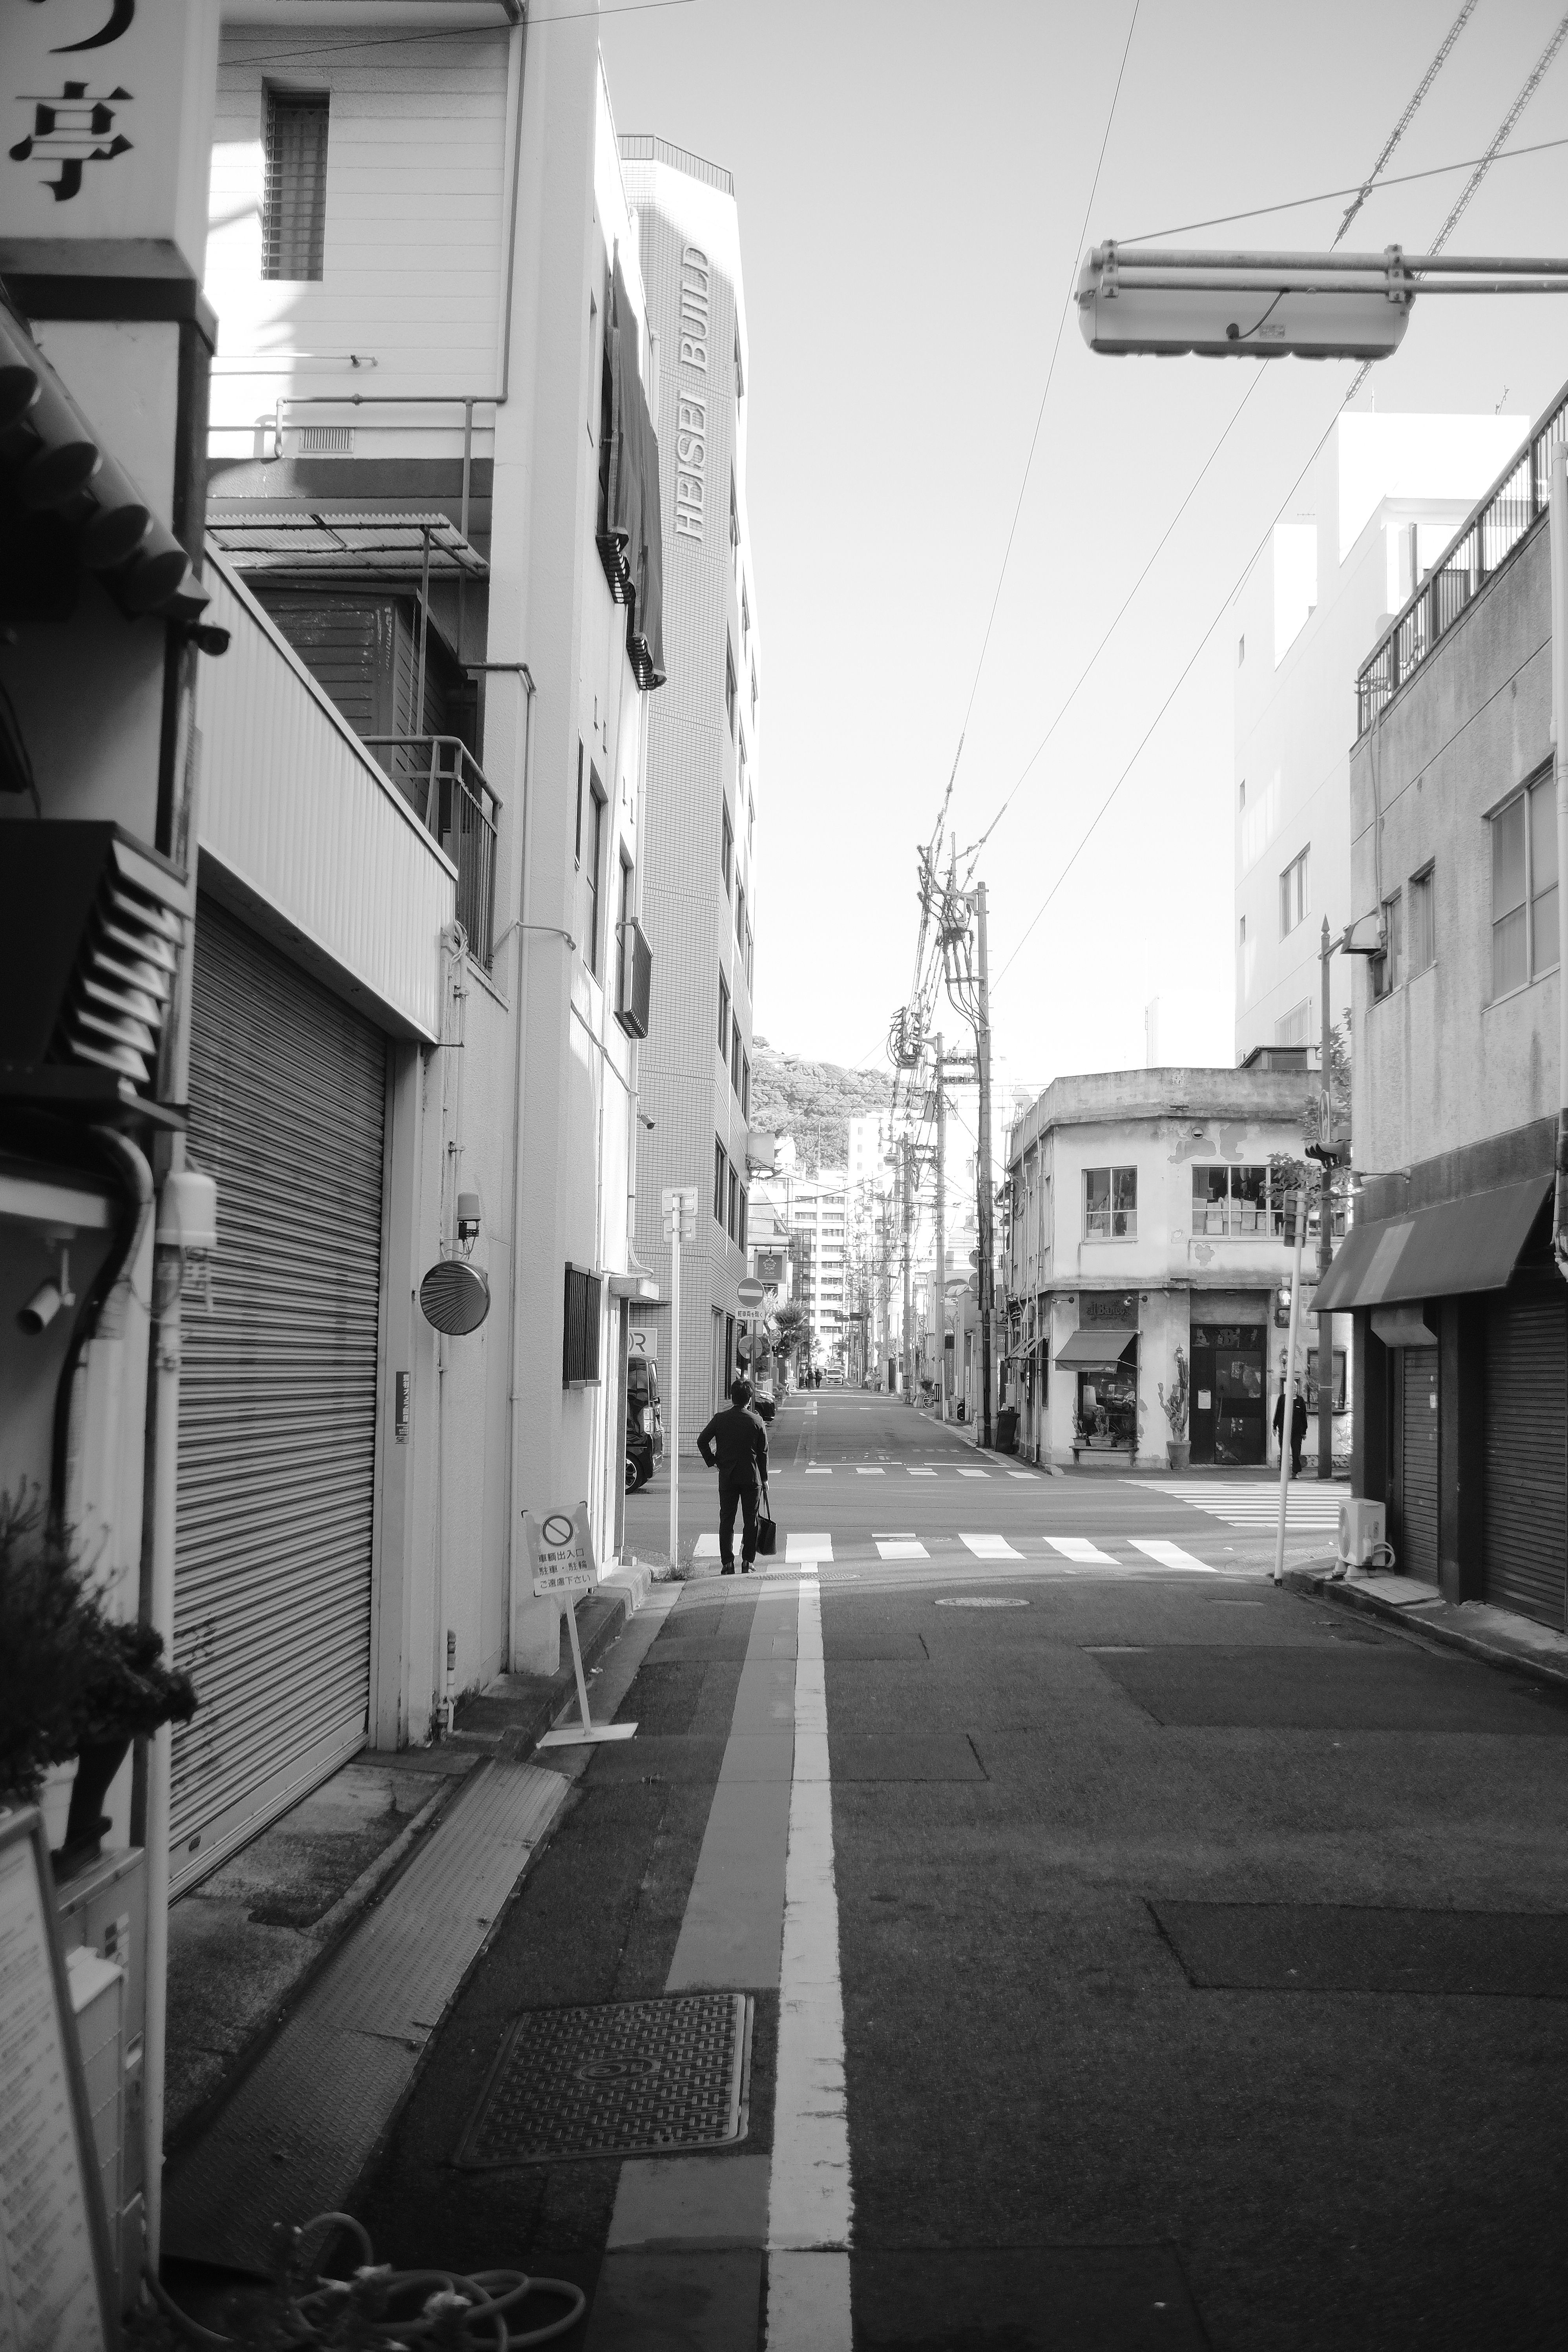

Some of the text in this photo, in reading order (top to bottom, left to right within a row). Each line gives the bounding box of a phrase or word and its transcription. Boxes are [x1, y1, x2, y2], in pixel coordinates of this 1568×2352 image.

[675, 241, 711, 542] HEISEI BUILD
[540, 1574, 590, 1588] ご遠慮下さい
